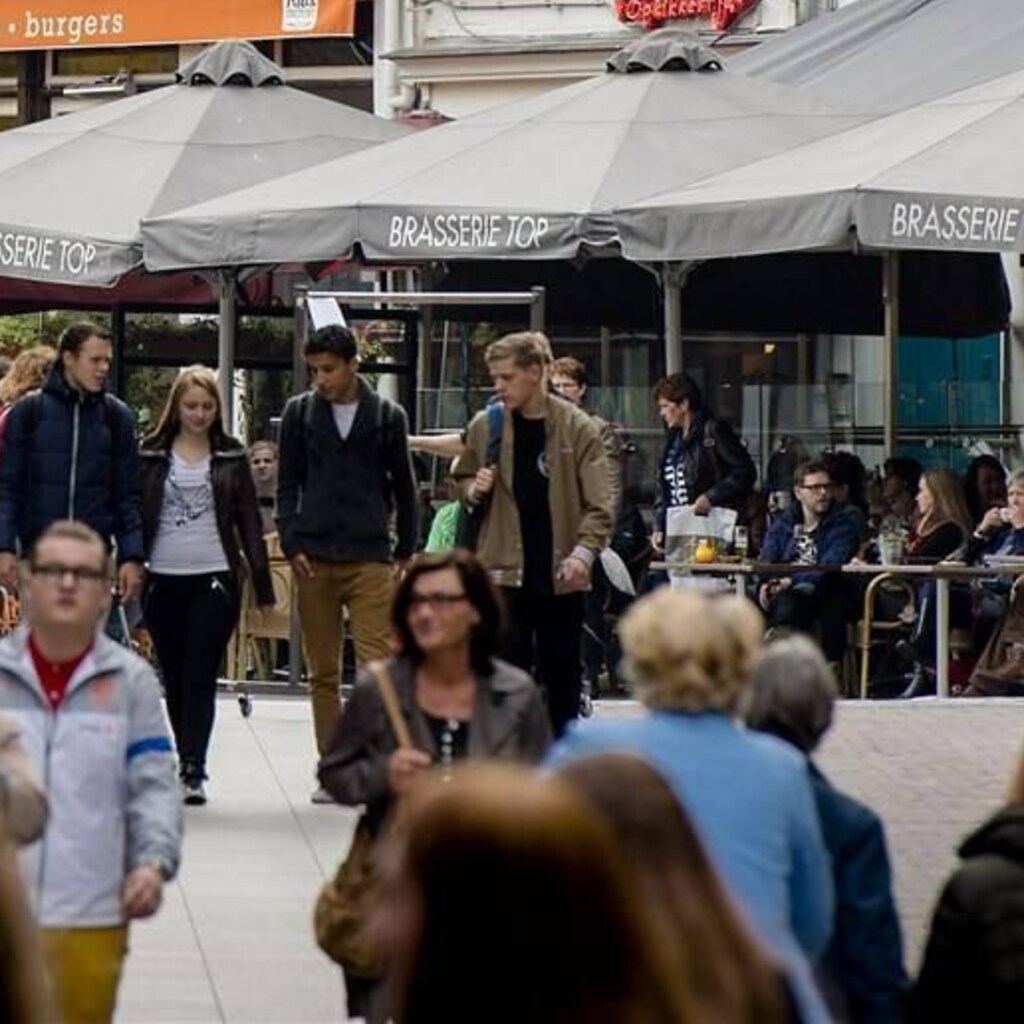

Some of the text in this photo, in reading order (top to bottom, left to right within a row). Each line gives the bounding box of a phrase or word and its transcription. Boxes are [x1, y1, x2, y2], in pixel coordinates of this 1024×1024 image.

[25, 10, 124, 43] burgers
[388, 213, 549, 249] BRASSERIE TOP
[891, 202, 1020, 243] BRASSERIE
[59, 239, 97, 275] TOP
